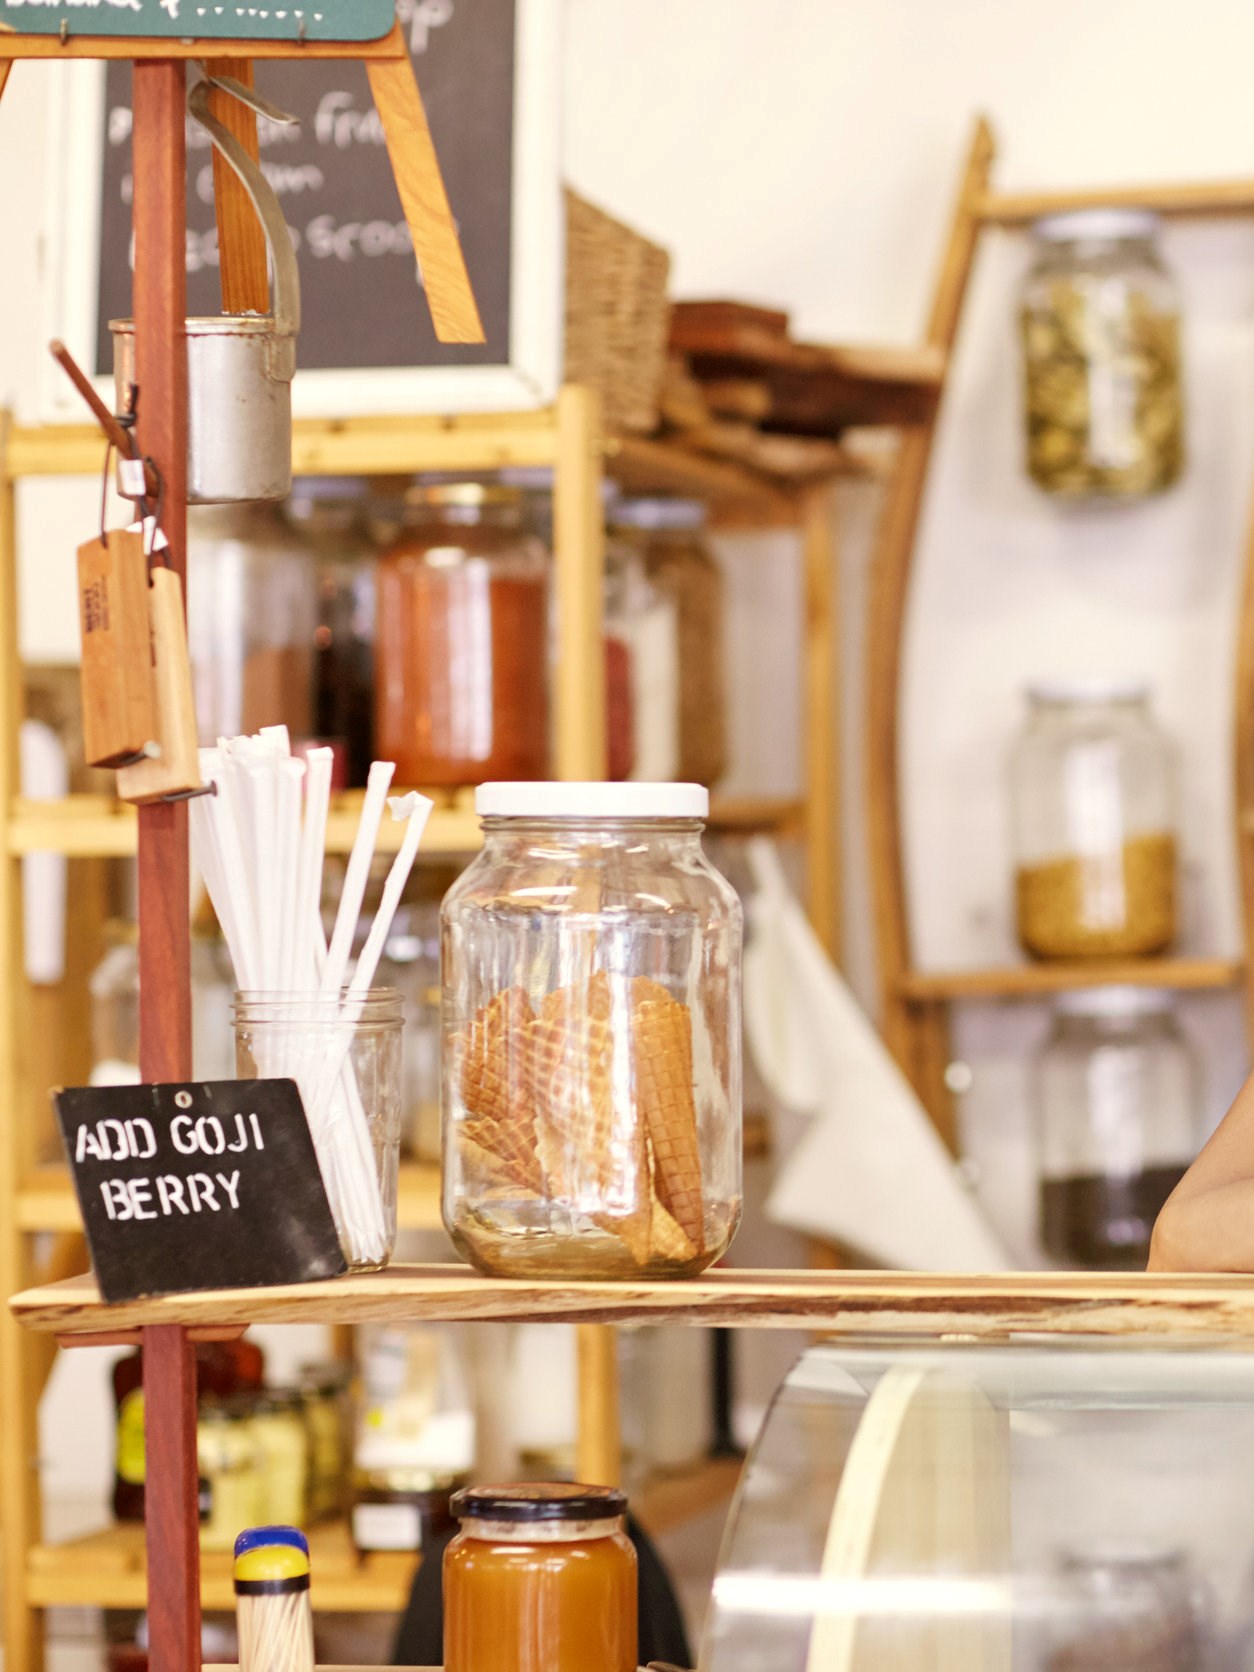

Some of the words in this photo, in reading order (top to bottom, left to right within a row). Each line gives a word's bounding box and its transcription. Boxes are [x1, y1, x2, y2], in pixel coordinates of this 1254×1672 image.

[75, 1117, 157, 1163] ADD
[169, 1113, 265, 1155] GOJI
[99, 1169, 240, 1221] BERRY
